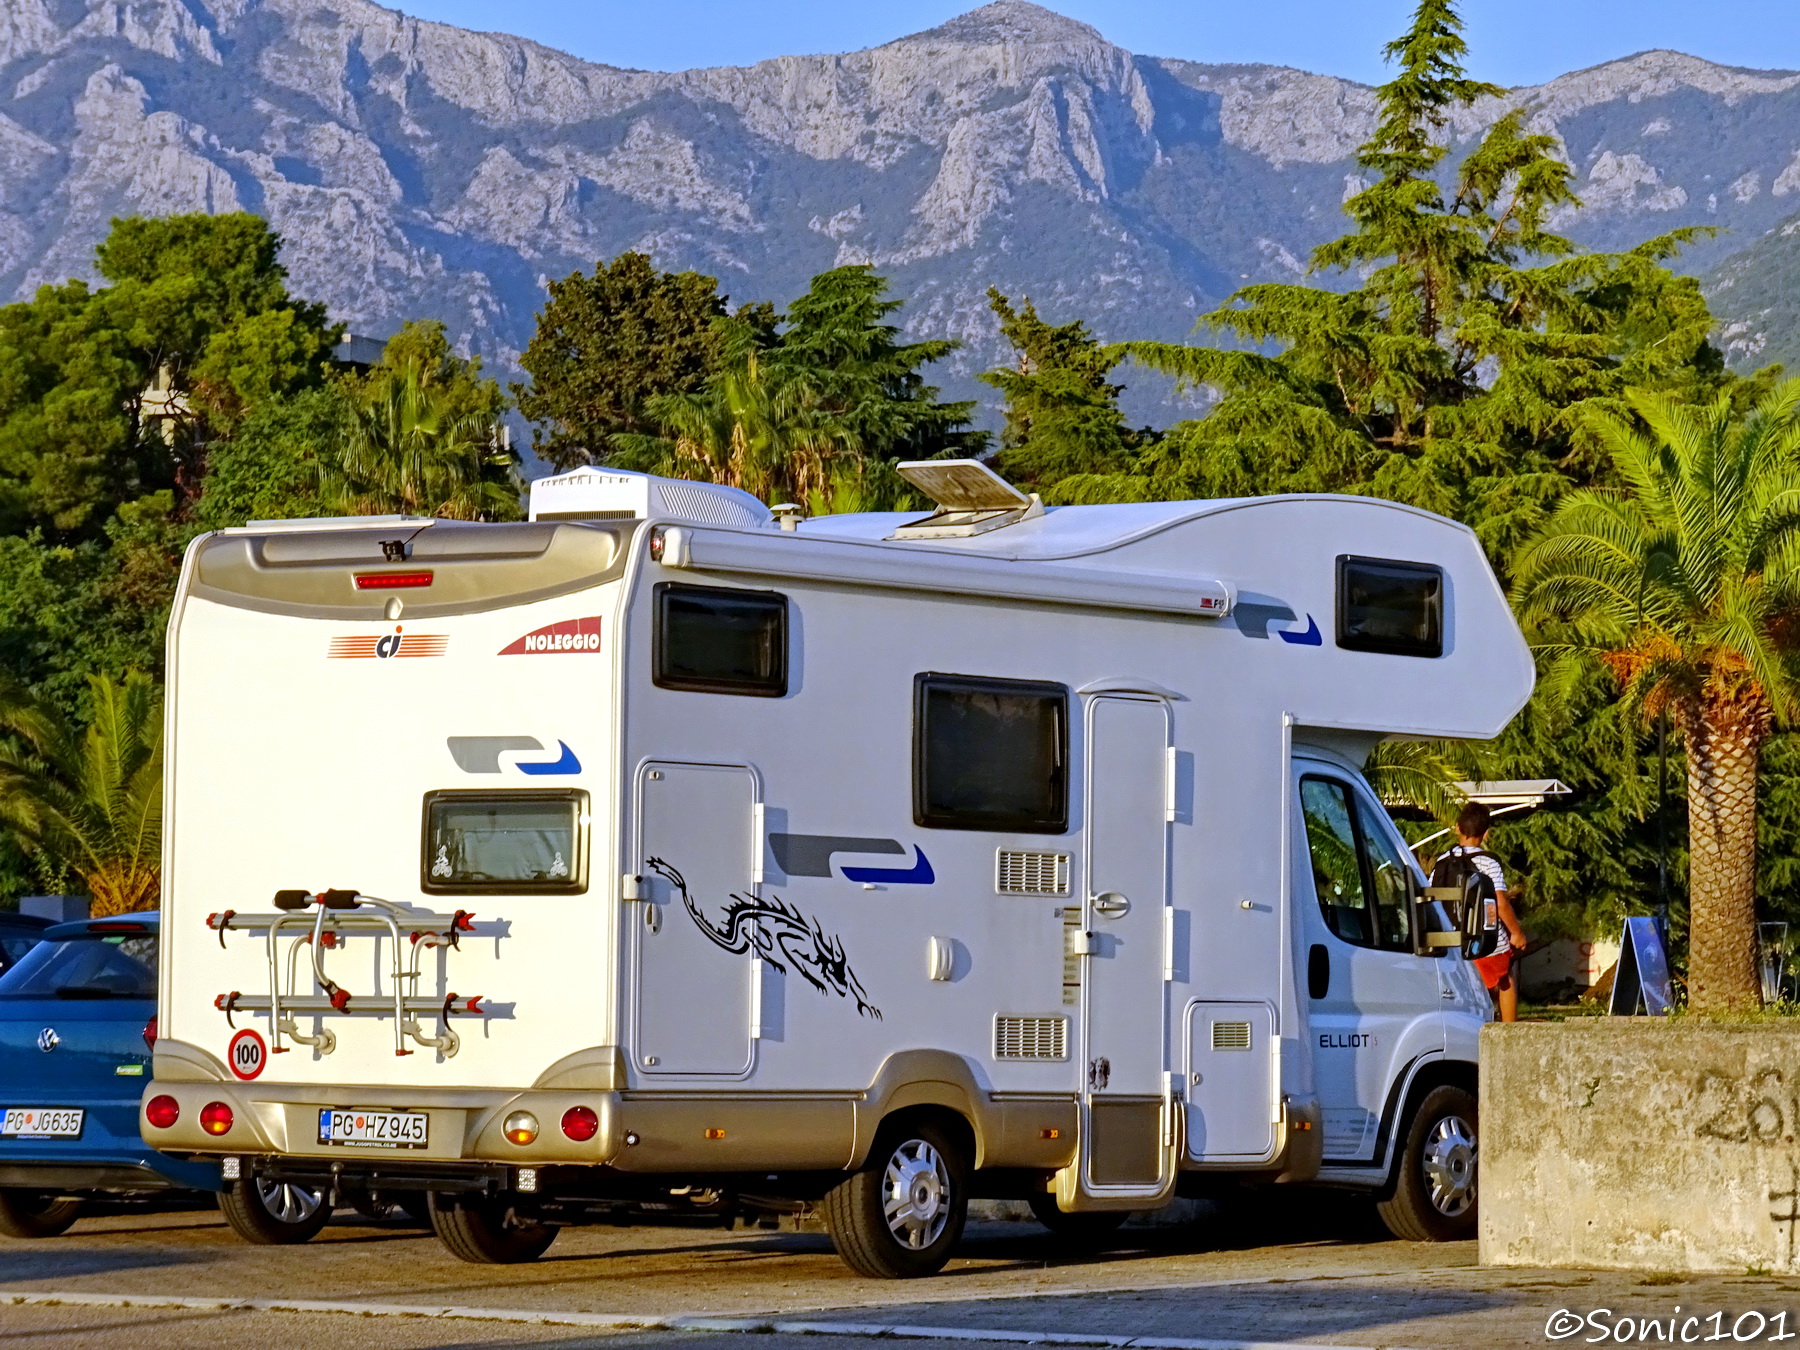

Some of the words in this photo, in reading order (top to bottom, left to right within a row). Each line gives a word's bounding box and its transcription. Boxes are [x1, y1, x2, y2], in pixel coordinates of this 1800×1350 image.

[525, 633, 600, 651] NOLEGGIO
[1320, 1034, 1369, 1047] ELLIOT
[235, 1044, 260, 1065] 100
[5, 1112, 24, 1131] PG
[32, 1113, 80, 1132] JG635
[332, 1114, 354, 1136] PG
[365, 1115, 424, 1140] HZ945
